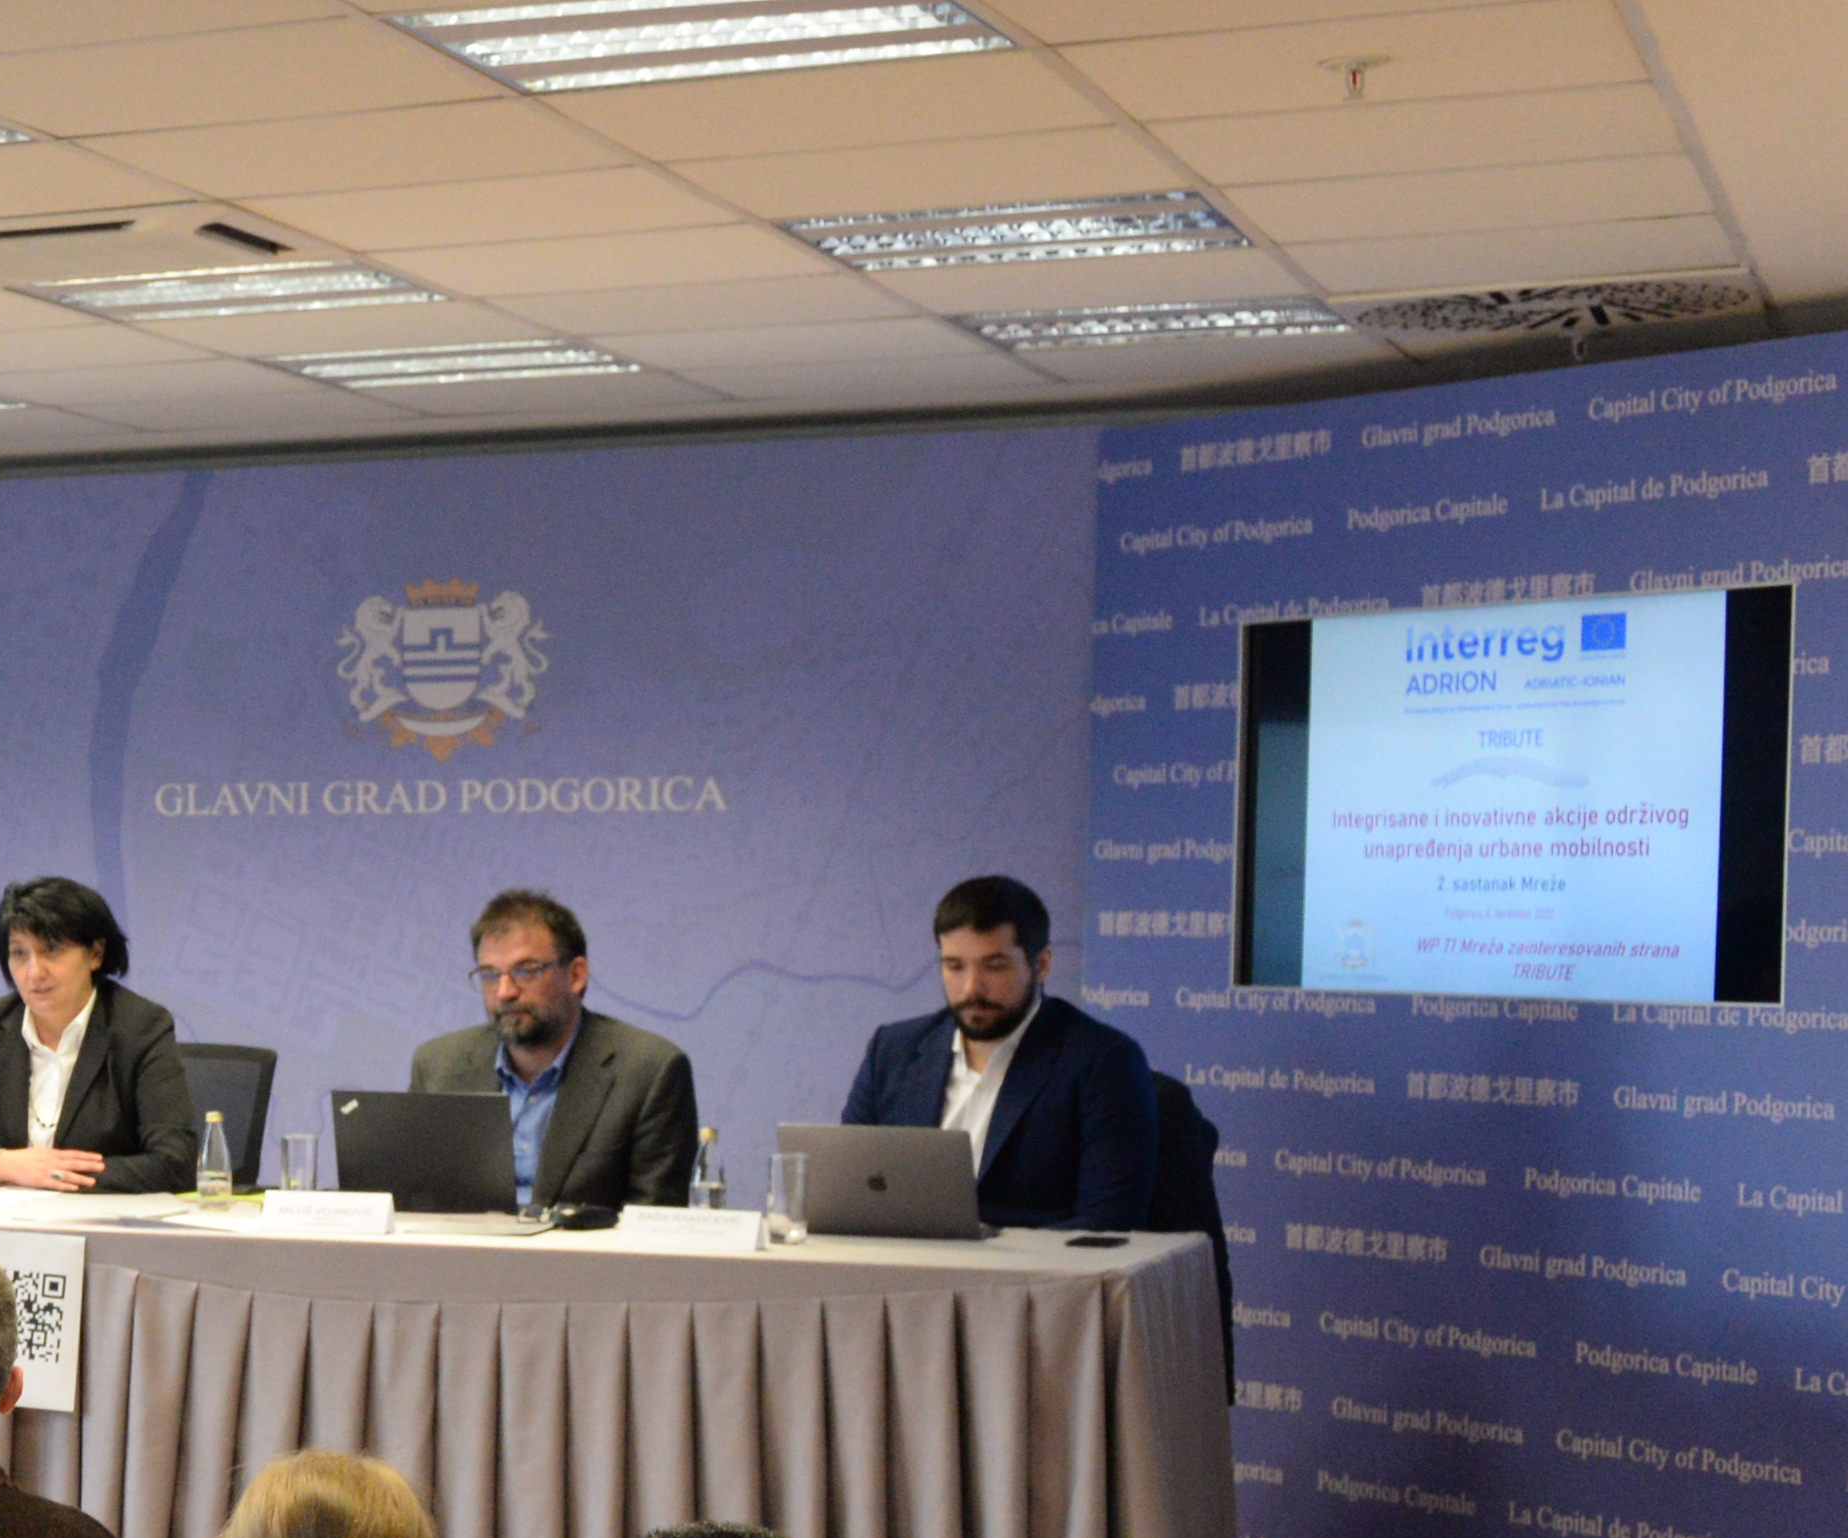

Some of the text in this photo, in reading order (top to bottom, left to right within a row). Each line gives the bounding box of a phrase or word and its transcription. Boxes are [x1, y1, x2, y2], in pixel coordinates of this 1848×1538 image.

[1588, 372, 1838, 423] Capital City of Podgorica
[1361, 408, 1556, 448] Glavni grad Podgorica
[1541, 468, 1769, 511] La Capital de Podgorica
[1347, 494, 1508, 532] Podgorica Capitale
[1405, 624, 1566, 663] Interreg
[1406, 670, 1498, 695] ADRION
[1478, 729, 1543, 749] TRIBUTE
[155, 776, 727, 816] GLAVNI GRAD PODGORICA
[1332, 809, 1428, 832] Integrisane
[1445, 808, 1537, 827] inovativne
[1544, 806, 1598, 830] akcije
[1606, 802, 1690, 829] održivog
[1364, 837, 1650, 862] unapređenja urbane mobilnosti
[1453, 876, 1517, 892] sastanak
[1521, 876, 1566, 892] Mreže
[1417, 937, 1441, 953] WP
[1460, 937, 1504, 955] Mreža
[1508, 940, 1626, 958] zainteresovanih
[1629, 943, 1680, 958] strana
[1513, 963, 1576, 981] TRIBUTE
[1613, 1085, 1835, 1123] Glavni grad Podgorica
[1274, 1148, 1332, 1176] Capital
[1336, 1154, 1373, 1182] City
[1376, 1156, 1396, 1179] of
[1400, 1158, 1486, 1187] Podgorica
[1524, 1167, 1702, 1204] Podgorica Capitale
[1737, 1182, 1843, 1217] La Capital
[1479, 1245, 1687, 1287] Glavni grad Podgorica
[1721, 1268, 1845, 1307] Capital City
[1319, 1312, 1537, 1358] Capital City of Podgorica
[1576, 1342, 1757, 1385] Podgorica Capitale
[1556, 1428, 1802, 1485] Capital City of Podgorica
[1509, 1501, 1531, 1526] La
[1536, 1506, 1603, 1537] Capital
